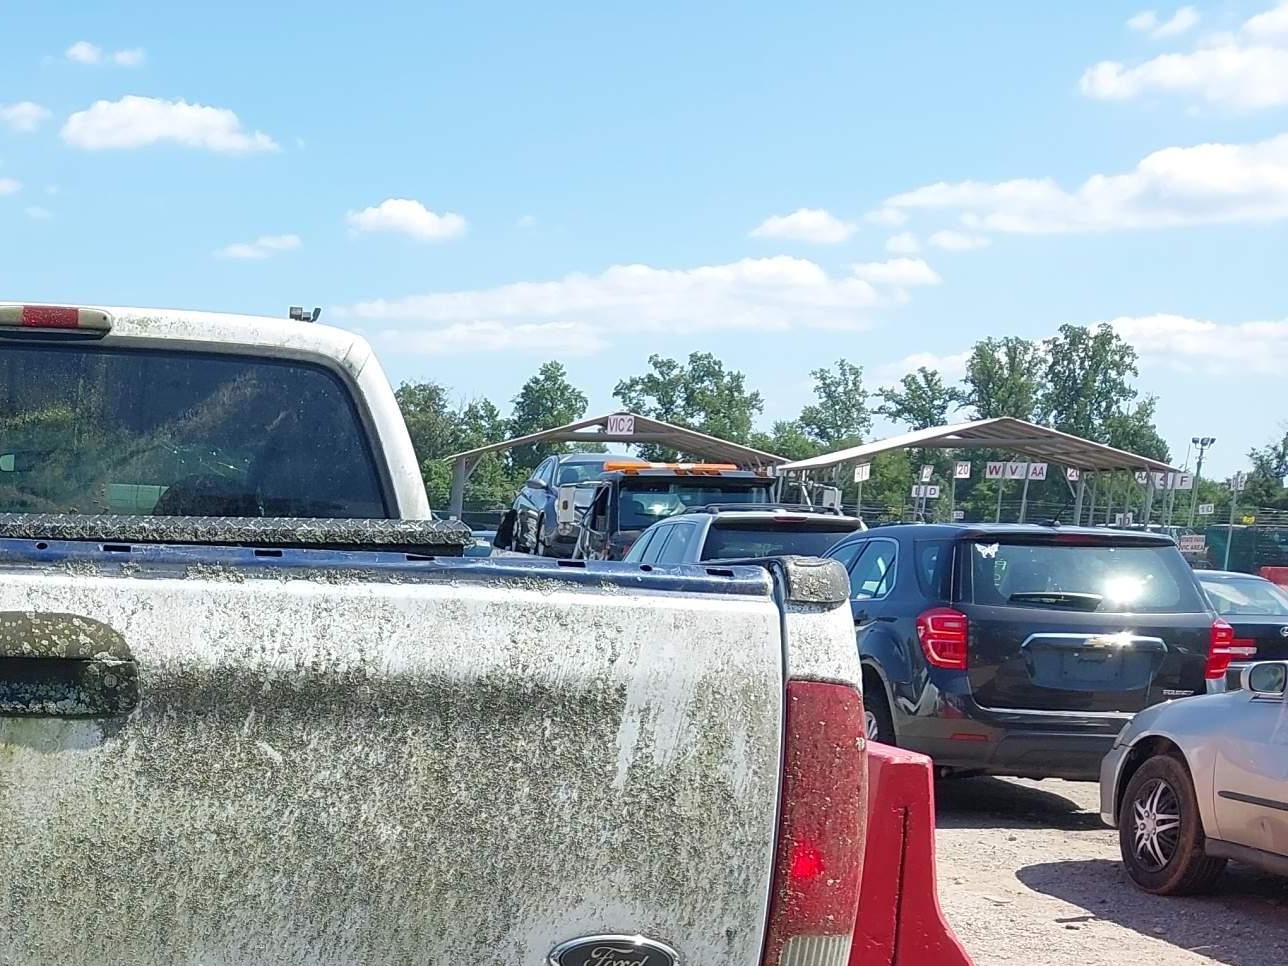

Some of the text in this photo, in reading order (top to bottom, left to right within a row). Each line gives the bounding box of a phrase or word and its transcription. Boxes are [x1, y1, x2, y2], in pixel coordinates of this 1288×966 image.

[609, 417, 633, 432] VIC 2
[958, 464, 969, 475] 20
[988, 465, 1001, 475] W
[1030, 465, 1044, 476] AA
[1180, 475, 1189, 486] F
